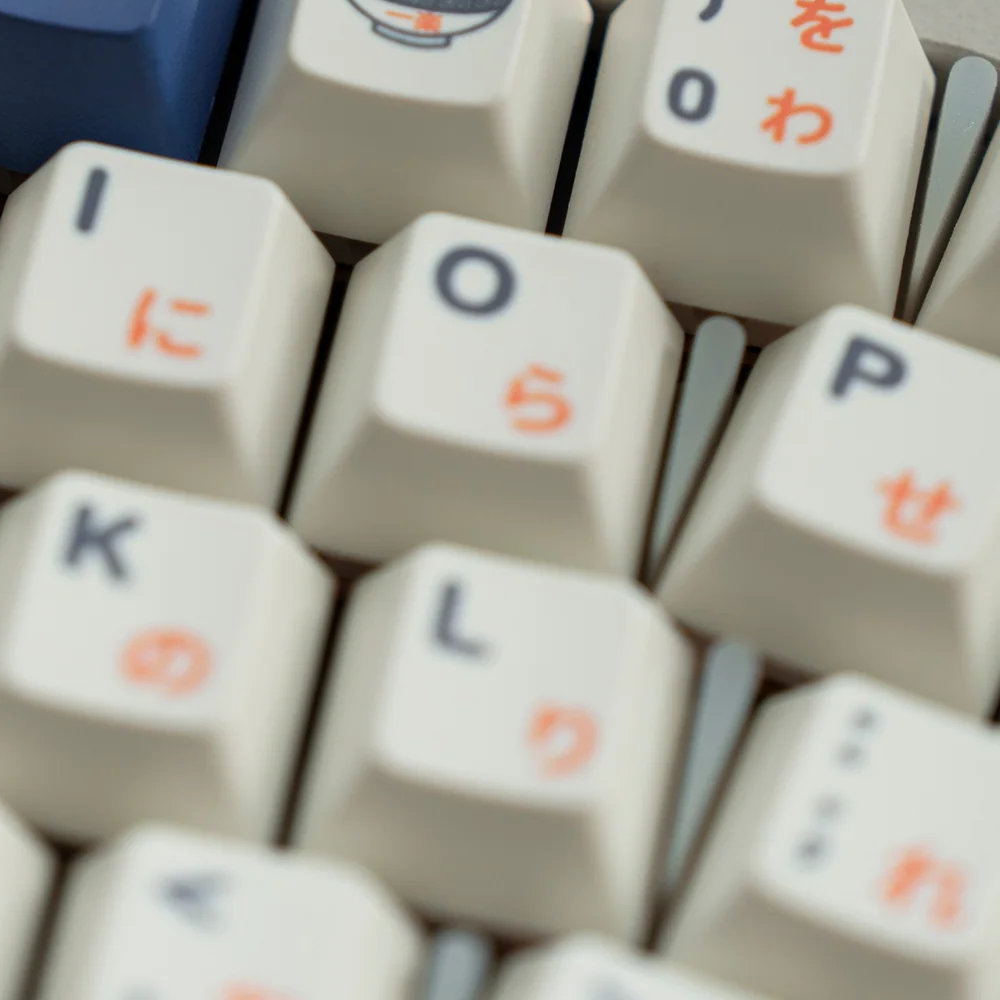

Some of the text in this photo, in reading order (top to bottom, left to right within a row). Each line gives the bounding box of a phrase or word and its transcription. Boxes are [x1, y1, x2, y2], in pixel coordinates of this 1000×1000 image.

[760, 87, 834, 145] わ
[433, 244, 518, 318] O
[126, 288, 209, 359] に
[504, 364, 573, 434] ら
[829, 334, 909, 400] P
[62, 503, 140, 582] K
[876, 471, 958, 545] せ
[430, 580, 488, 659] L
[121, 627, 214, 696] の
